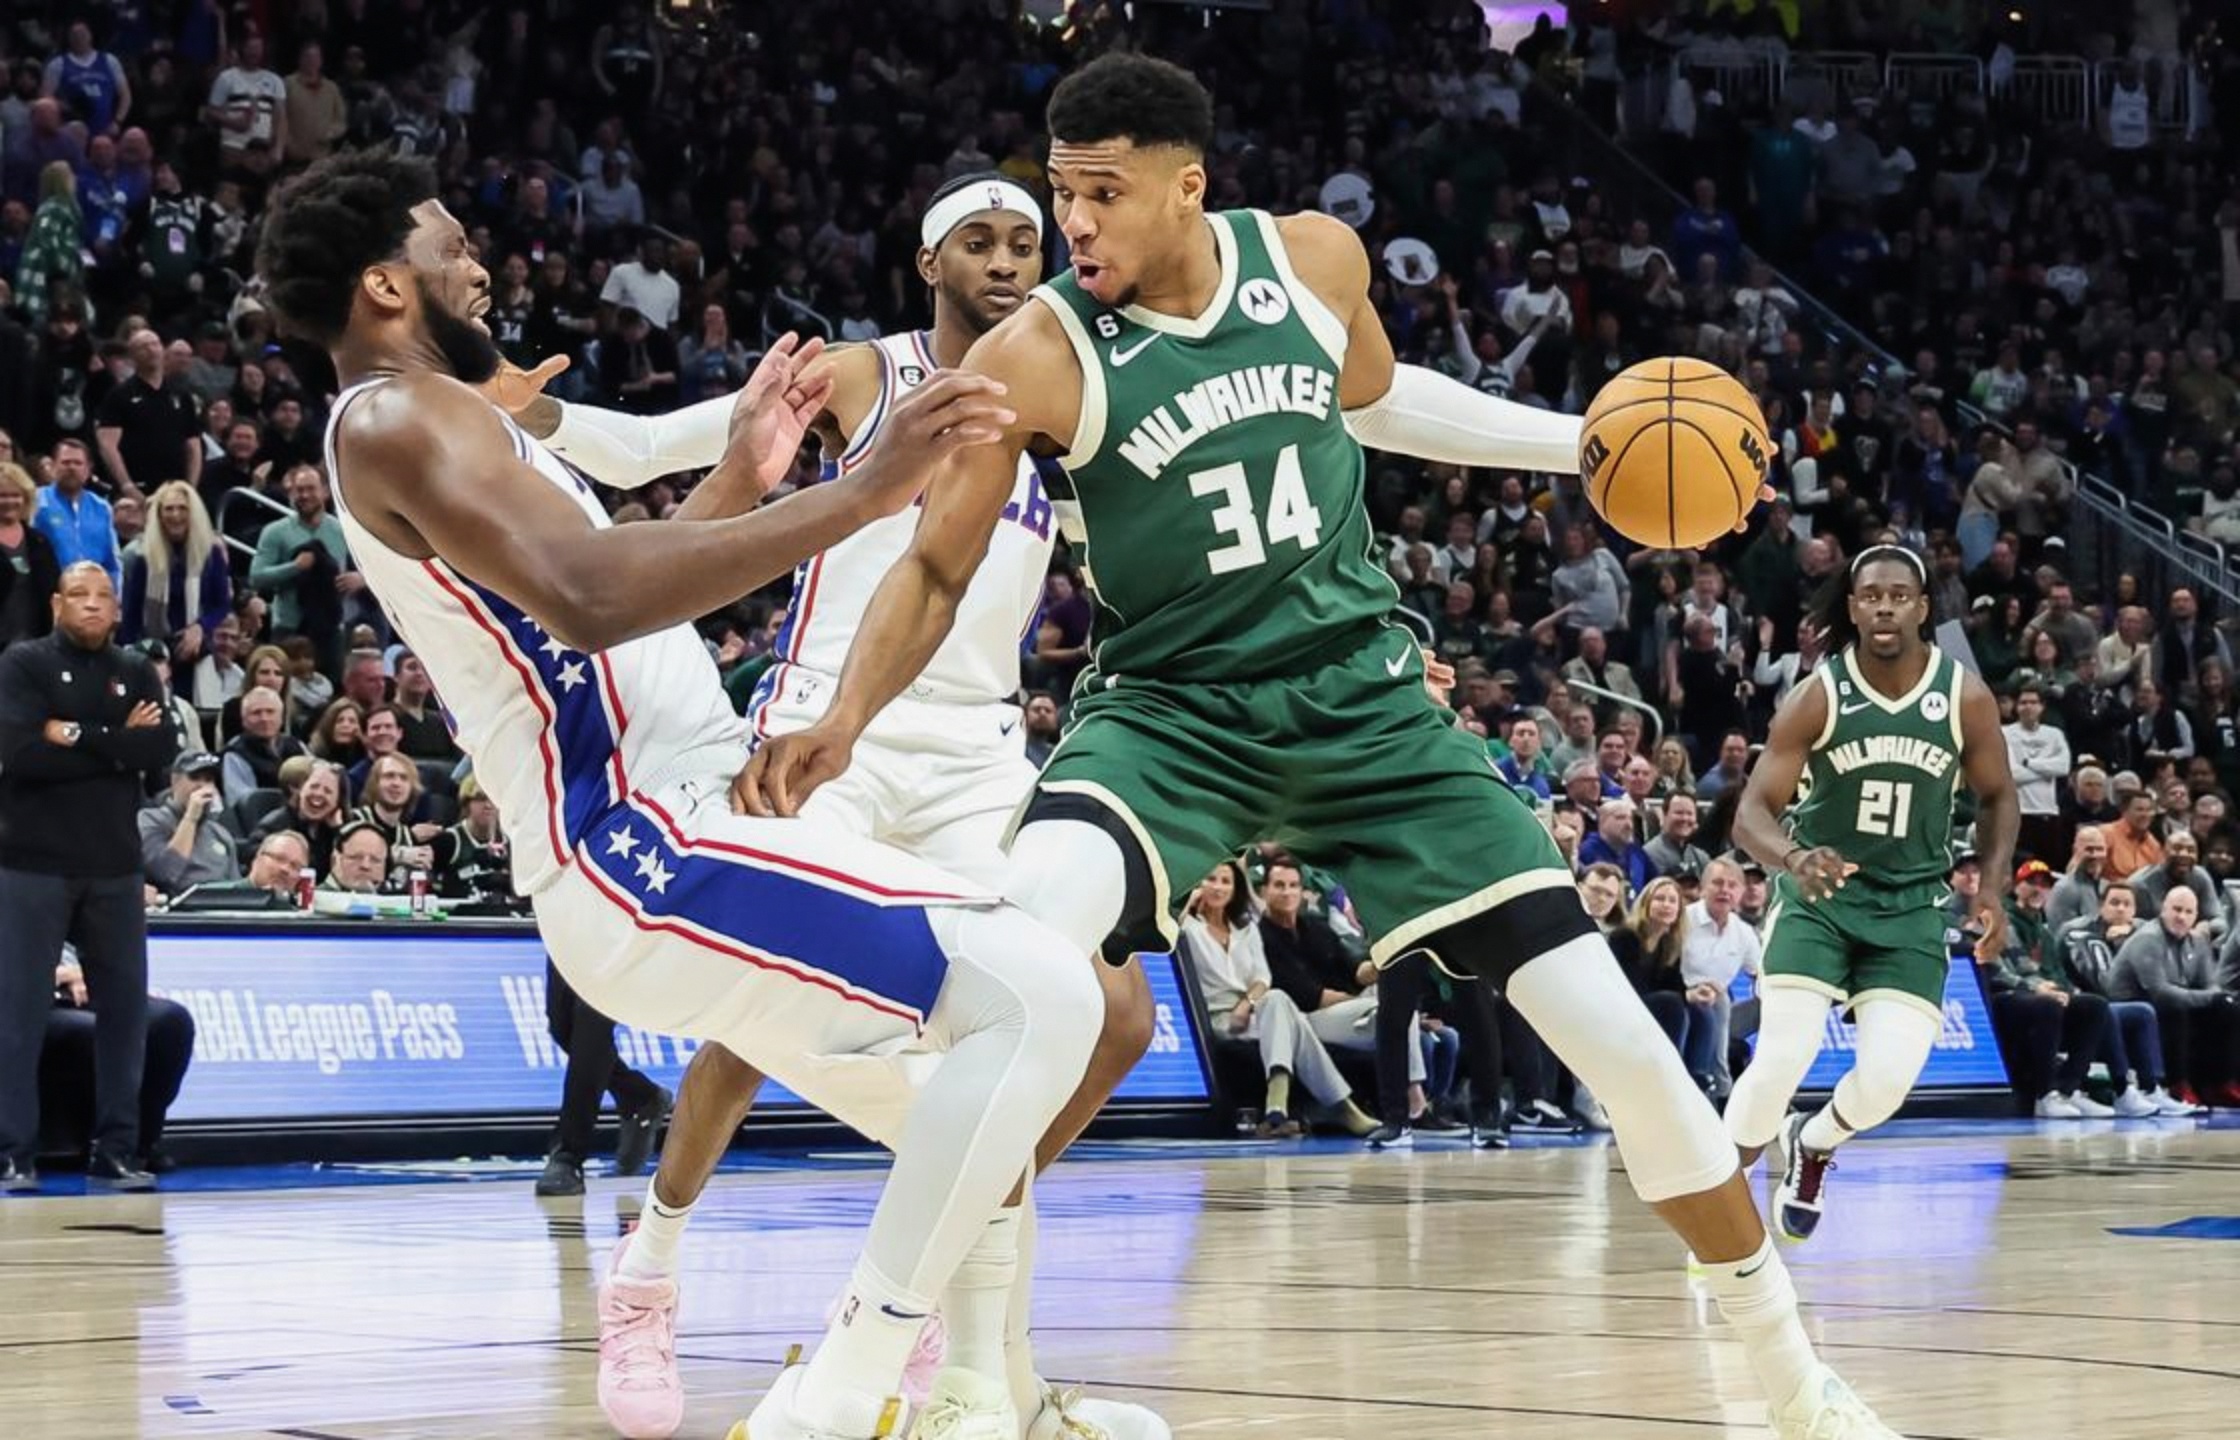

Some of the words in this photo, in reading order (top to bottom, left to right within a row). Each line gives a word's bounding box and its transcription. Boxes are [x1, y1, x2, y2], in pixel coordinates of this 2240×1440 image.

[1095, 314, 1119, 339] 6
[903, 368, 920, 385] 6
[1117, 363, 1335, 481] MILWAUKEE
[1187, 443, 1323, 576] 34
[1825, 735, 1953, 779] MILWAUKEE
[1855, 779, 1913, 839] 21
[243, 989, 377, 1075] League
[370, 988, 464, 1060] Pass
